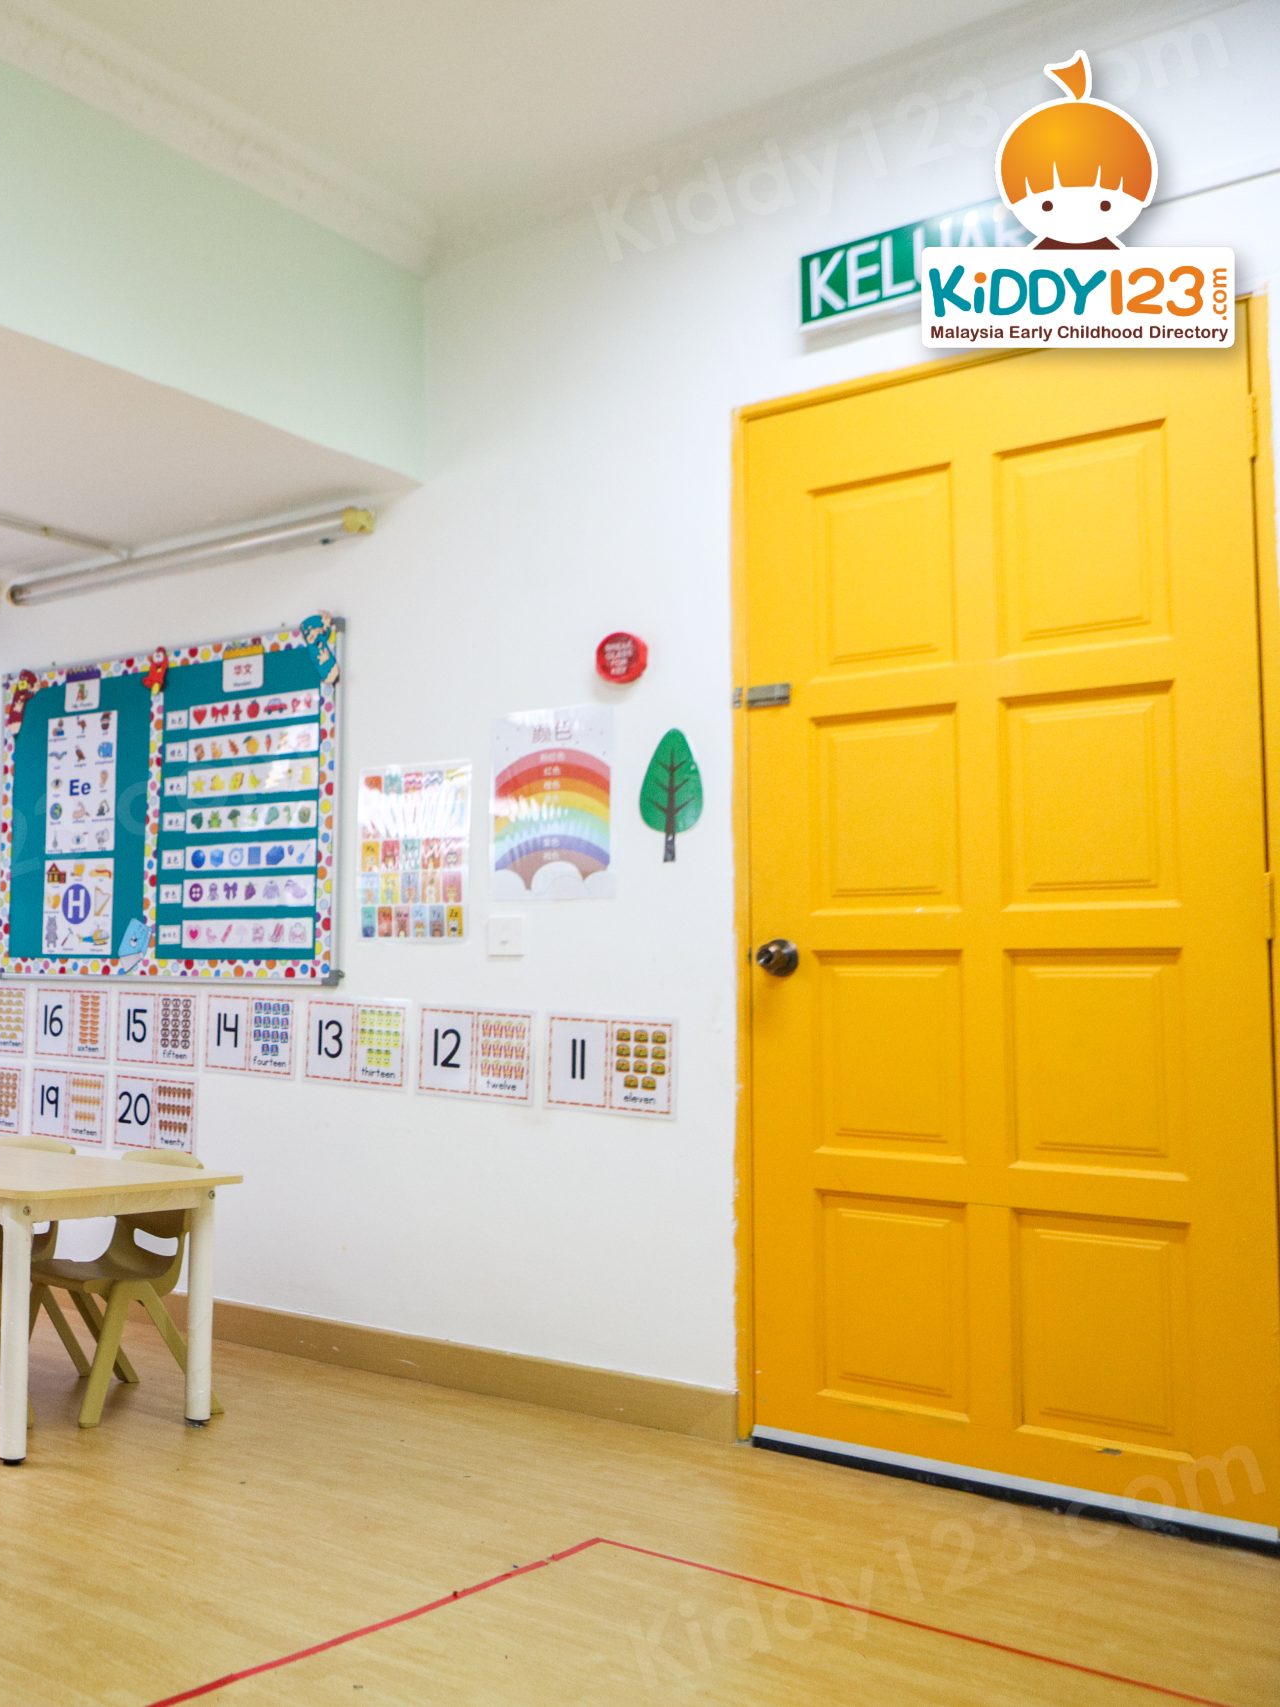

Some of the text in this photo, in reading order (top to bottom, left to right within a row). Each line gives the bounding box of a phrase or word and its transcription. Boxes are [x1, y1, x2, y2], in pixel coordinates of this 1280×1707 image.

[69, 779, 91, 796] Ee
[68, 889, 85, 919] H
[43, 1004, 64, 1037] 16
[126, 1008, 148, 1043] 15
[216, 1012, 239, 1049] 14
[77, 1045, 99, 1053] sixteen
[317, 1018, 343, 1059] 13
[433, 1028, 462, 1069] 12
[162, 1050, 188, 1061] fifteen
[252, 1057, 287, 1069] fourteen
[571, 1038, 586, 1080] 11
[361, 1067, 396, 1080] thirteen
[486, 1080, 517, 1093] twelve
[40, 1084, 60, 1119] 19
[118, 1091, 151, 1126] 20
[623, 1095, 656, 1106] eleven
[71, 1127, 98, 1137] nineteen
[160, 1136, 185, 1149] twenty
